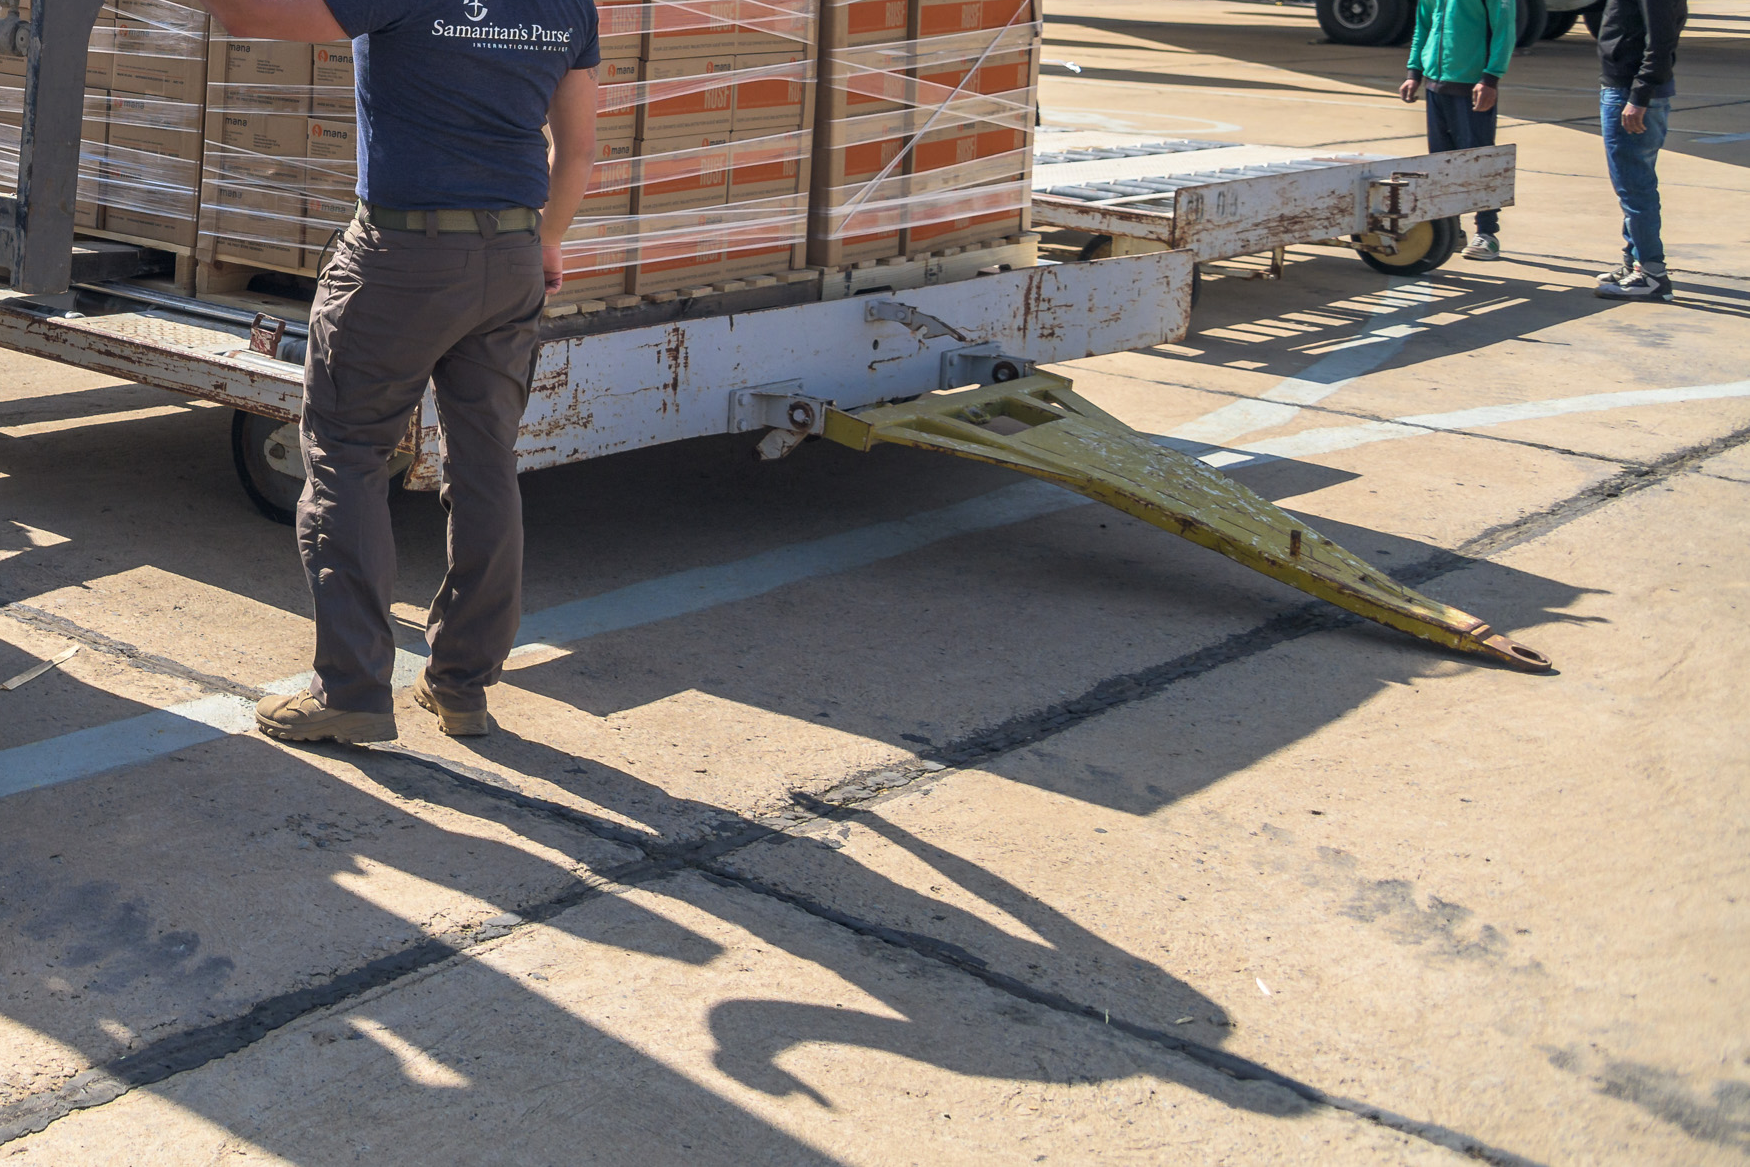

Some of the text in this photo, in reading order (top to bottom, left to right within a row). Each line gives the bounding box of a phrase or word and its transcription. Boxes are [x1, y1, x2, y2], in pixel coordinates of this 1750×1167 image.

[885, 0, 906, 28] RUSF
[431, 19, 528, 41] Samaritan's
[229, 43, 251, 53] mana
[472, 42, 568, 53] INTERNATIONAL RELIEF
[330, 54, 354, 64] mana
[616, 66, 635, 75] mana
[713, 62, 731, 73] mana
[704, 81, 730, 109] RUSF
[123, 99, 145, 109] mana
[225, 117, 248, 127] mana
[323, 128, 348, 139] mana
[611, 145, 630, 155] mana
[700, 154, 726, 185] RUSF
[321, 202, 346, 214] mana
